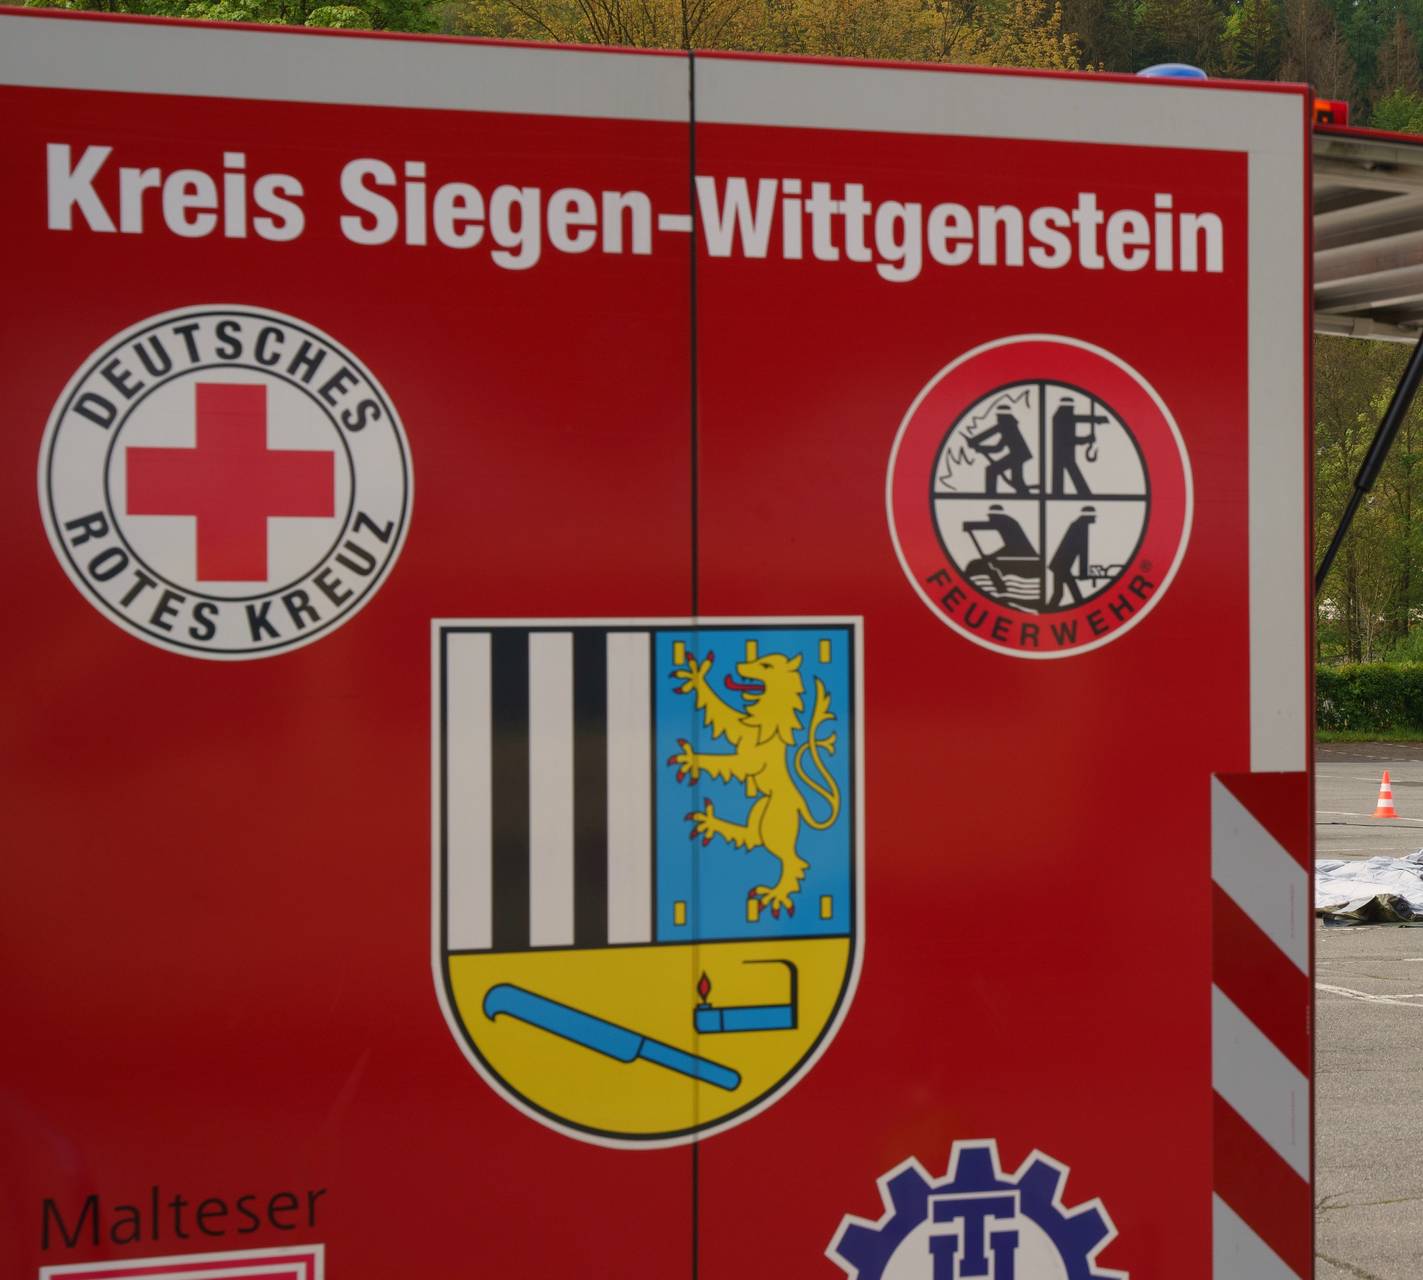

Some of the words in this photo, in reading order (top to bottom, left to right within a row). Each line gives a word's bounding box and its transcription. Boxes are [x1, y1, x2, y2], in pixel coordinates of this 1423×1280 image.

[46, 142, 305, 242] Kreis
[339, 157, 1224, 283] Siegen-Wittgenstein
[72, 320, 382, 433] DEUTSCHES
[64, 510, 220, 642] ROTES
[245, 510, 395, 642] KREUZ
[41, 1185, 328, 1250] Malteser
